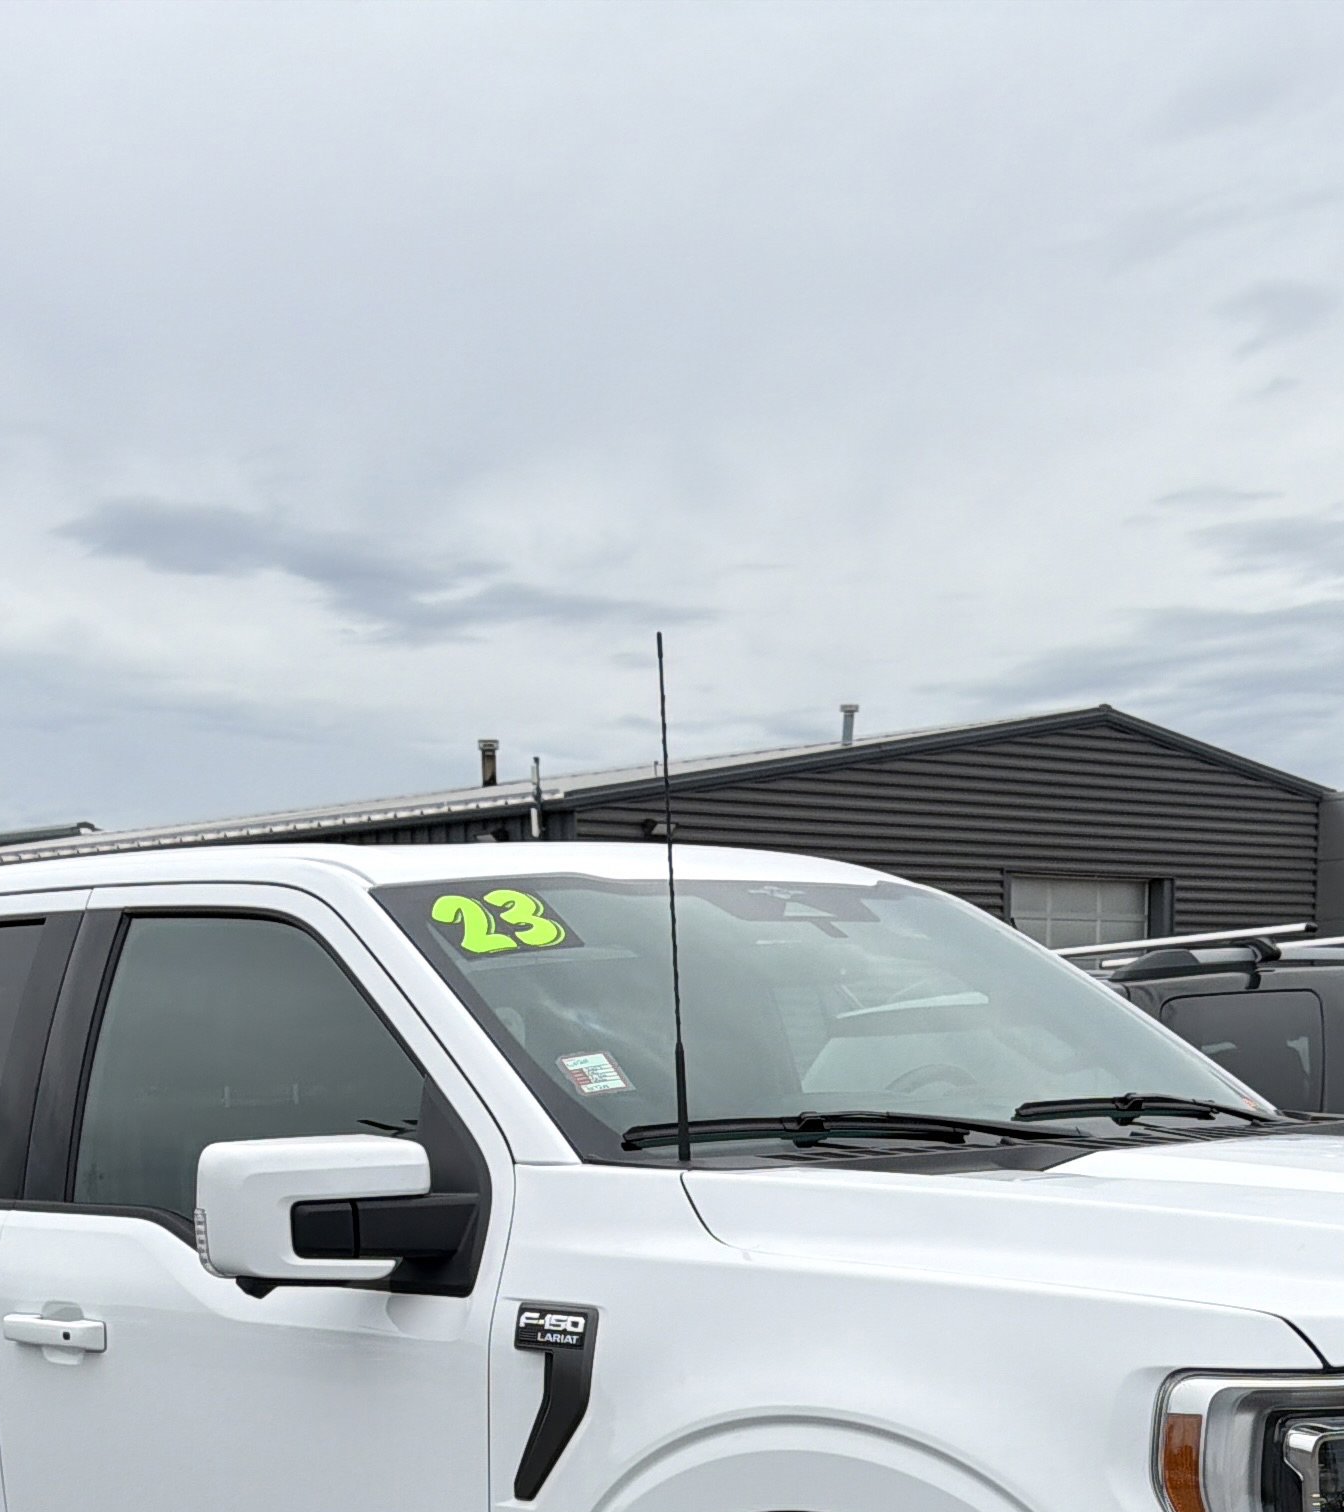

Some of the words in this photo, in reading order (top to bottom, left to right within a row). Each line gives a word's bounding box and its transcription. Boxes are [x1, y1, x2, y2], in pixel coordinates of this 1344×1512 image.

[432, 889, 566, 954] 23
[519, 1311, 586, 1333] F-150
[537, 1332, 580, 1344] LARIAT
